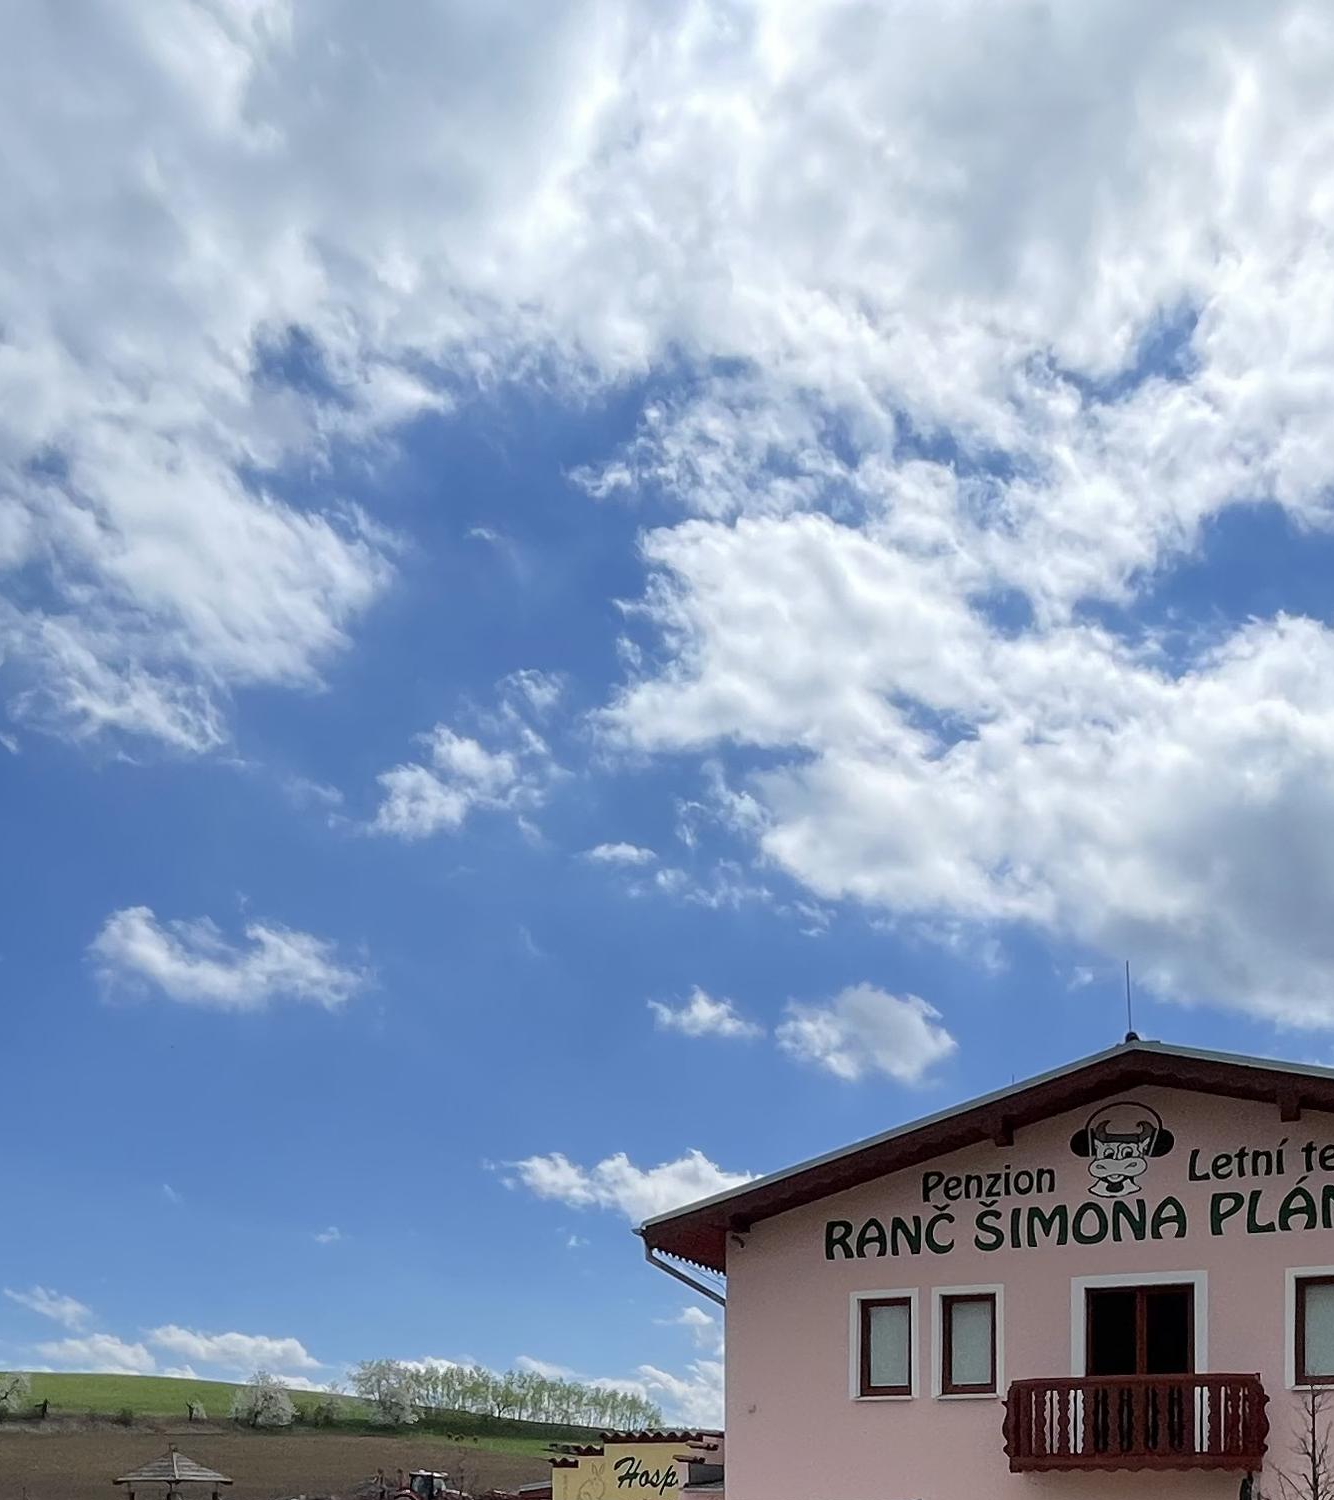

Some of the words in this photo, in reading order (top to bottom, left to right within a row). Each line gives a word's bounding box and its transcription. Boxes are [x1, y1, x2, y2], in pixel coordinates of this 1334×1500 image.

[1186, 1137, 1289, 1183] Letní
[921, 1164, 1057, 1203] Penzion
[824, 1203, 955, 1261] RANČ
[973, 1198, 1188, 1252] ŠIMONA
[613, 1456, 679, 1496] Hosp
